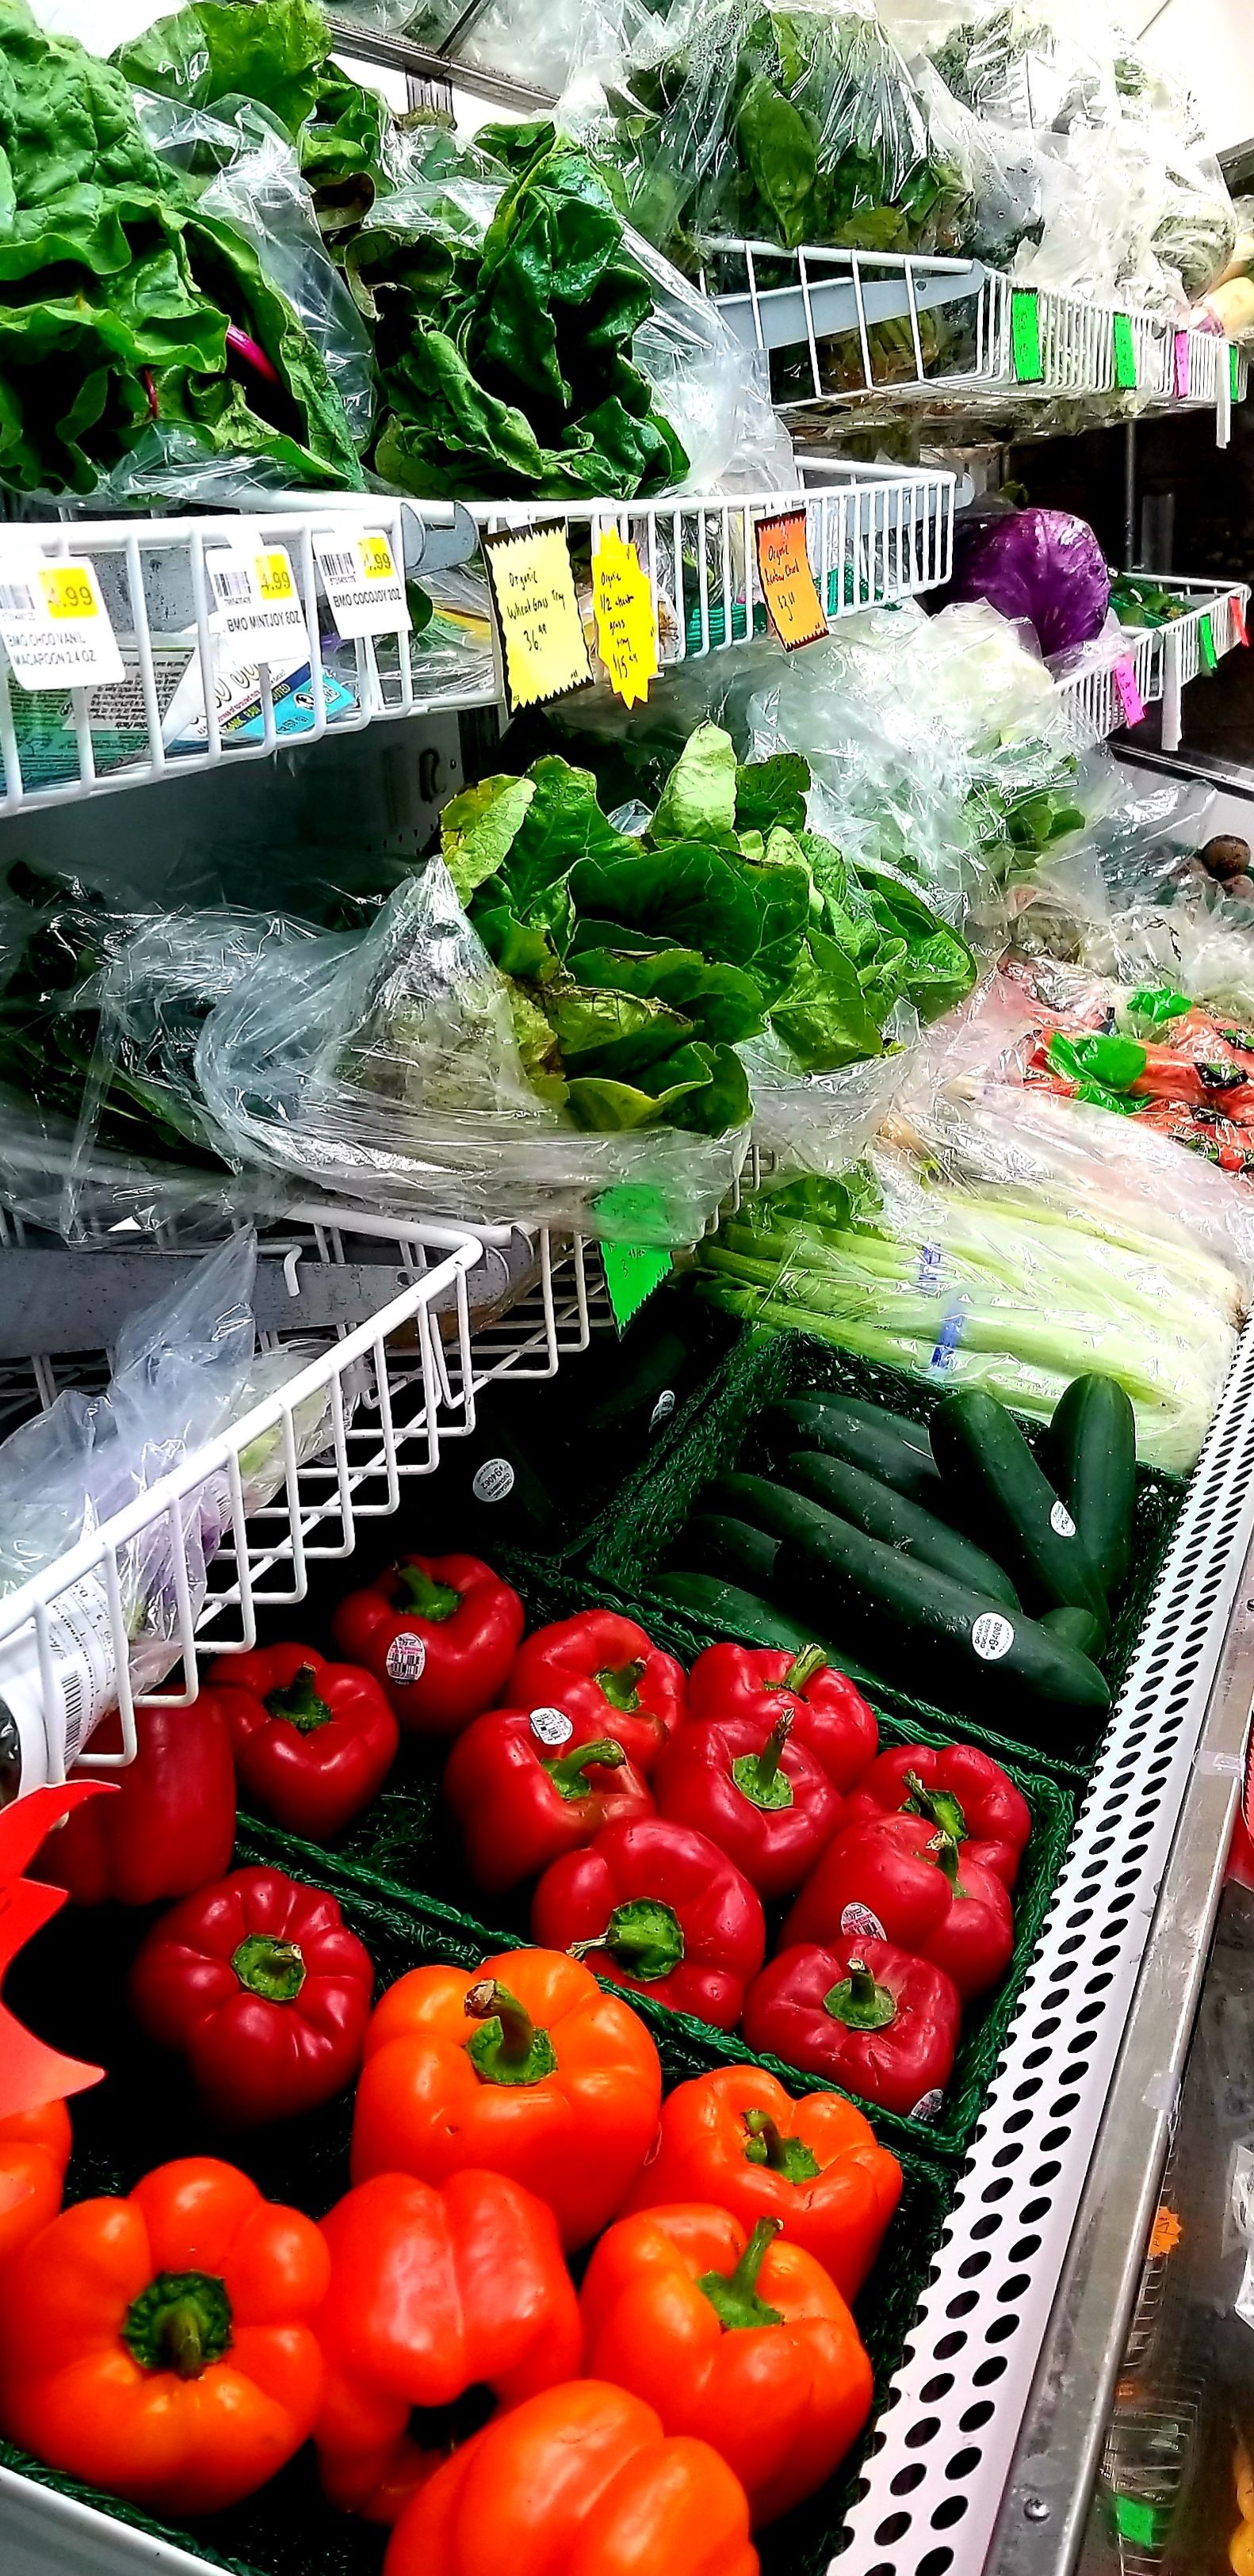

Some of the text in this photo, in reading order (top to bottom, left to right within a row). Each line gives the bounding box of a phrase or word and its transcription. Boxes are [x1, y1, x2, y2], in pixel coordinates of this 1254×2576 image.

[259, 571, 292, 591] 4.99
[48, 586, 93, 608] 4.99
[333, 593, 353, 608] BMO
